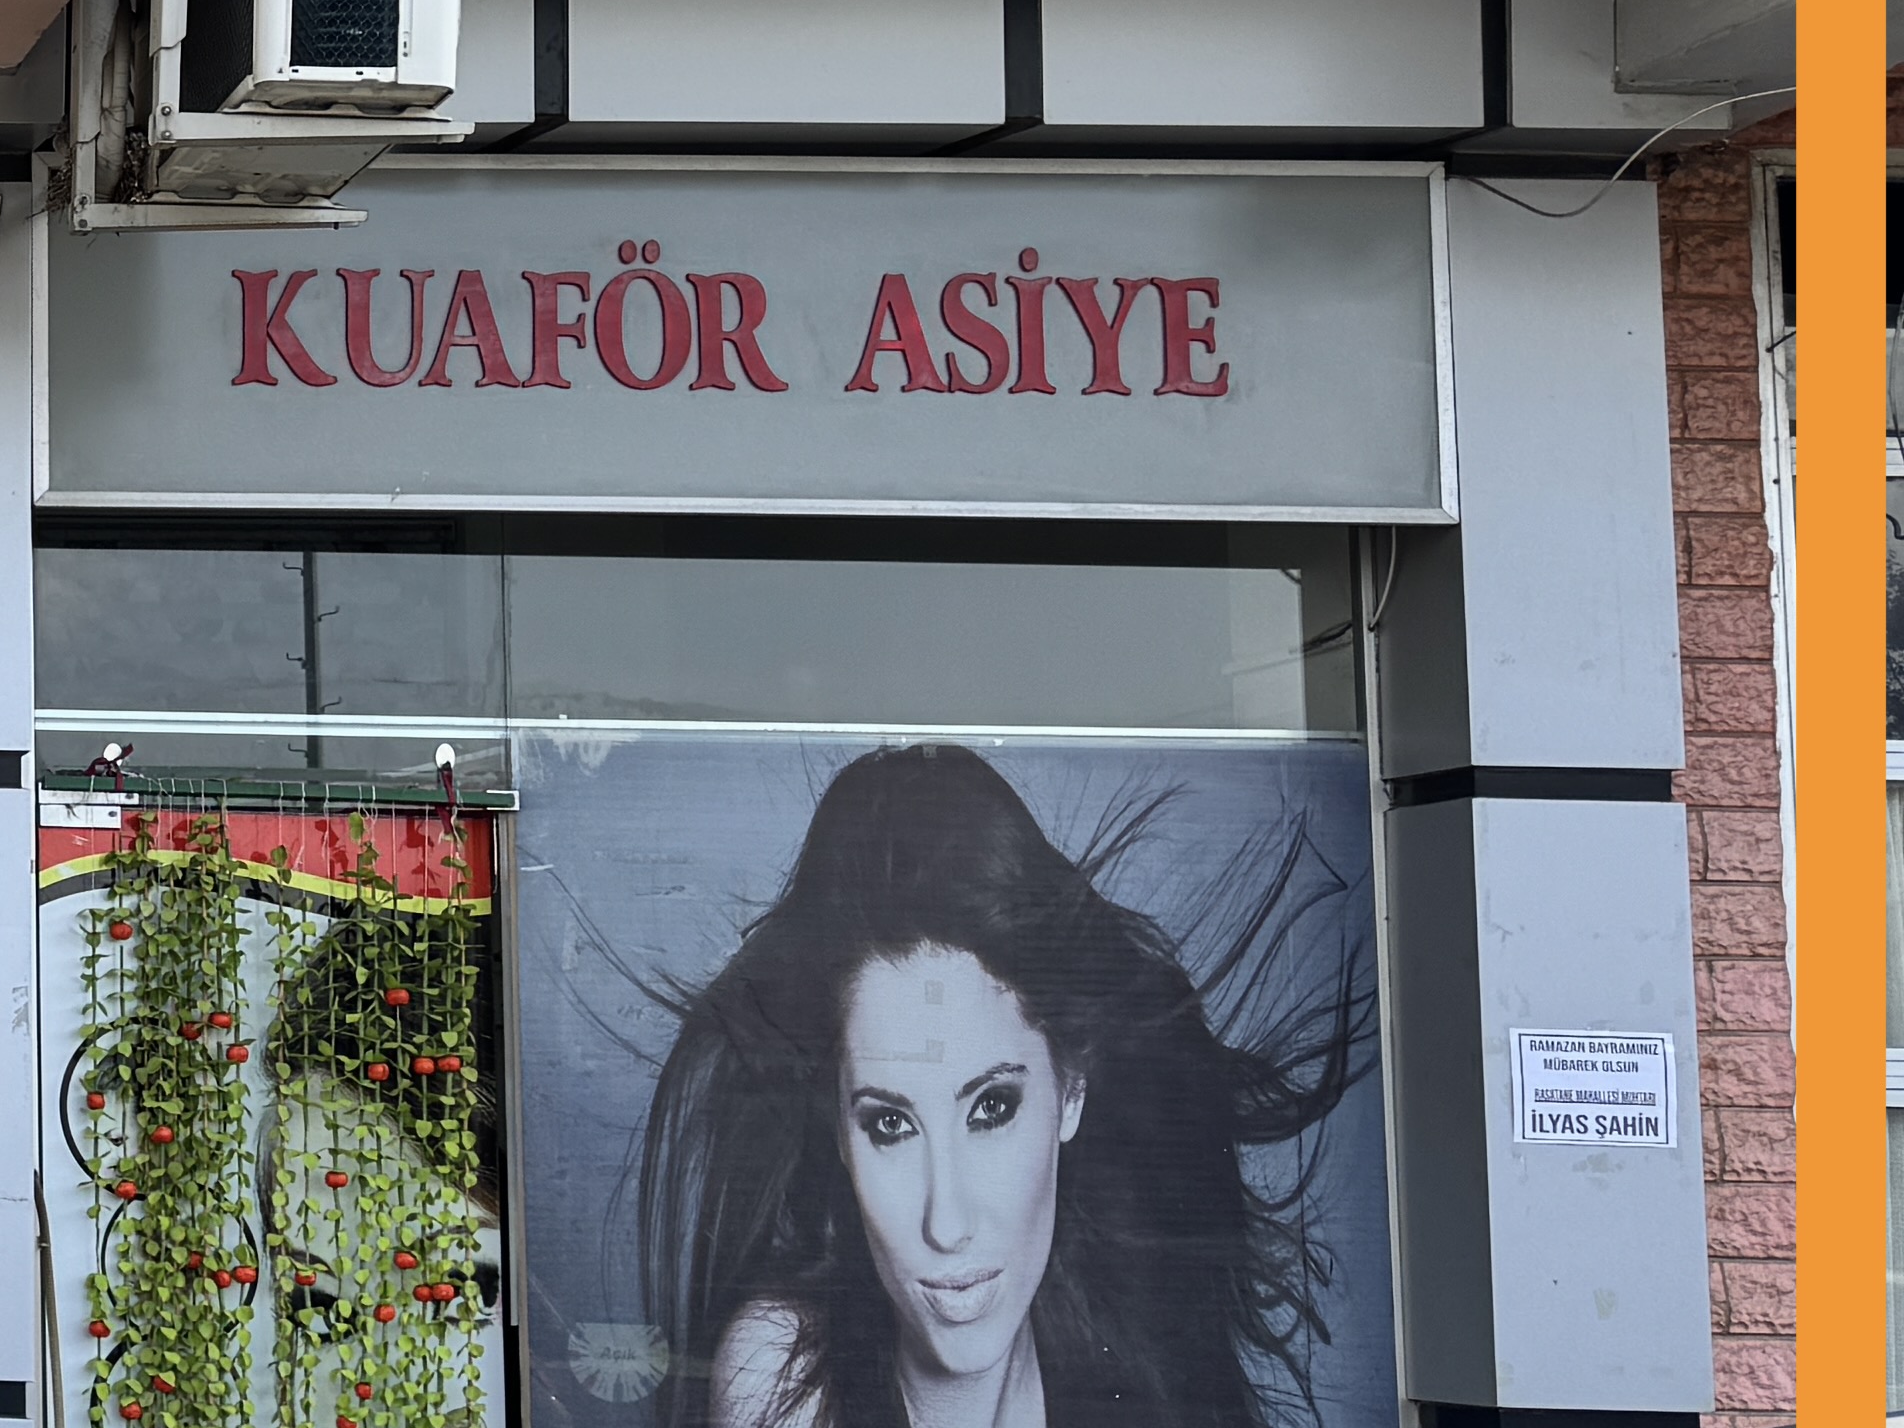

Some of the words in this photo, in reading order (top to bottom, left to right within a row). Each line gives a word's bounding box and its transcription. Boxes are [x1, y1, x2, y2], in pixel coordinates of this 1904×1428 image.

[231, 238, 789, 392] KUAFÖR
[844, 247, 1229, 398] ASİYE
[1530, 1039, 1586, 1053] RAMAZAN
[1543, 1057, 1599, 1072] MÜBAREK
[1602, 1060, 1639, 1073] OLSUN
[1531, 1109, 1589, 1134] İLYAS
[1595, 1112, 1659, 1139] ŞAHİN
